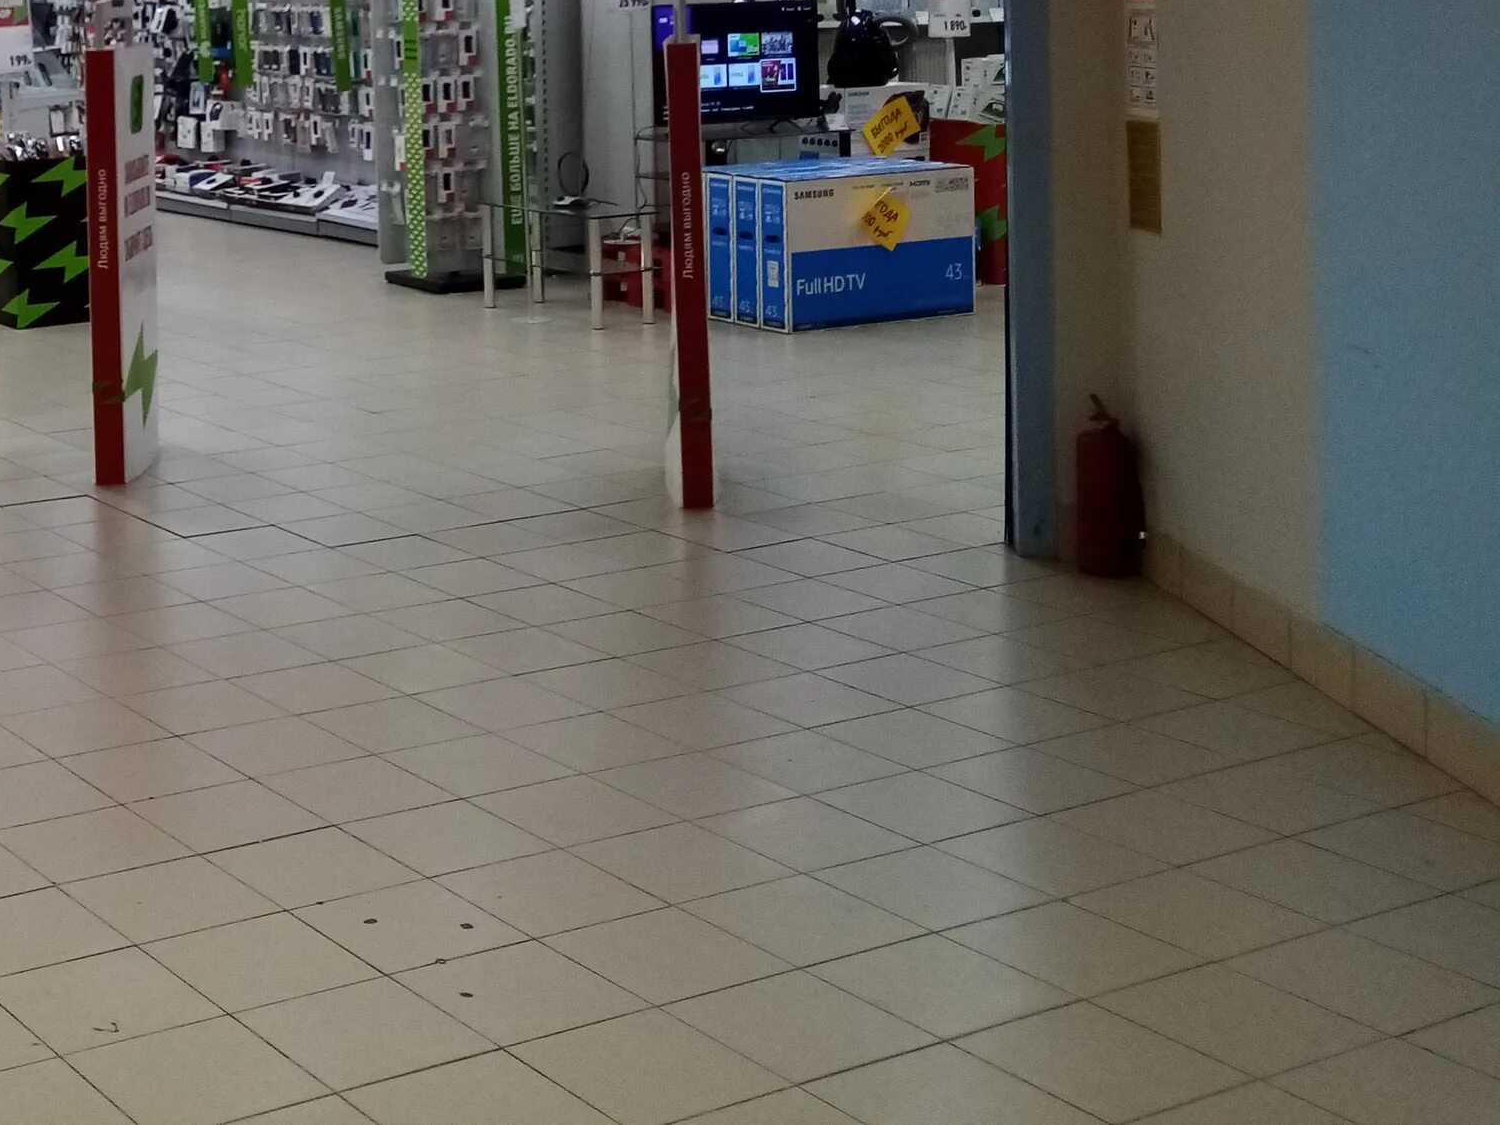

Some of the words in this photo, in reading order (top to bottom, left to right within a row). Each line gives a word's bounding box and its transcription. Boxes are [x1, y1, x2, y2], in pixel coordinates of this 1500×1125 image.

[97, 168, 108, 223] выгодно
[681, 171, 692, 230] выгодно
[794, 189, 835, 201] SAMSUNG
[98, 225, 109, 269] Людям
[682, 232, 694, 280] Людям
[945, 263, 963, 280] 43
